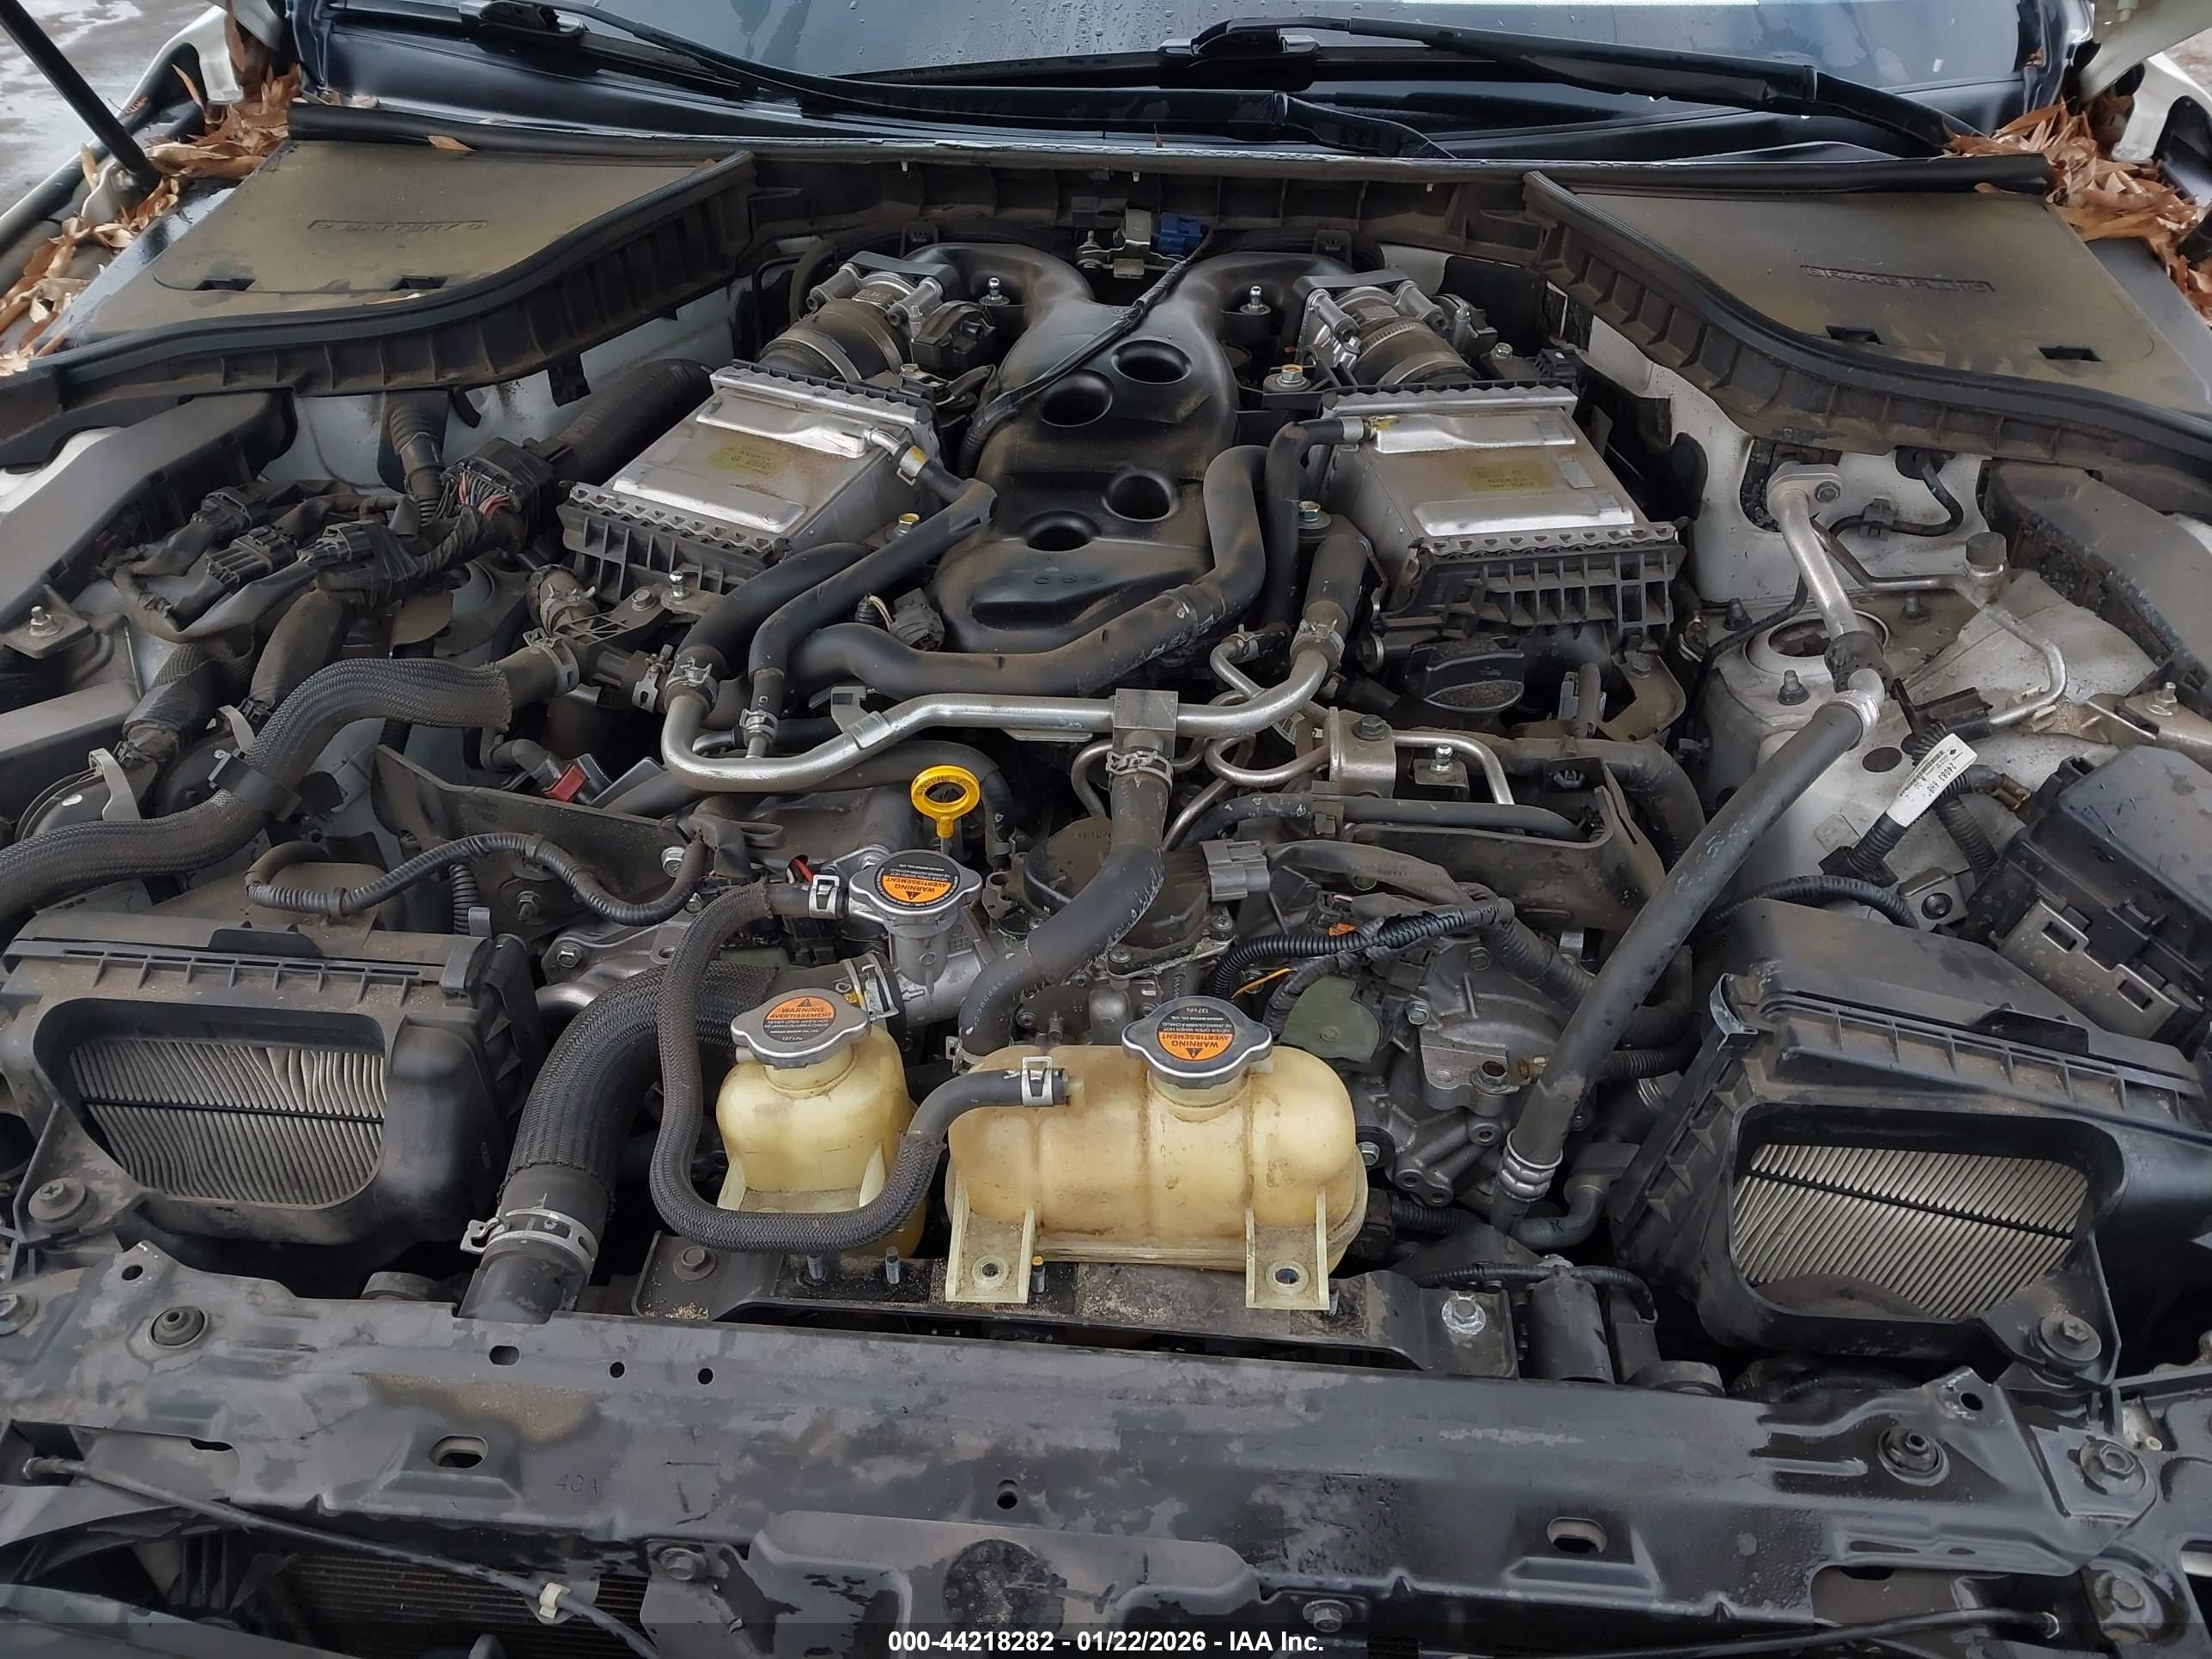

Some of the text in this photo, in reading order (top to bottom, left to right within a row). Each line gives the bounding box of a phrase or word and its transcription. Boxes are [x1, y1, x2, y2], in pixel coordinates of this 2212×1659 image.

[1805, 266, 1988, 293] BRAKE FLUID
[885, 877, 948, 888] AVERTISSEMENT
[895, 884, 934, 893] WARNING
